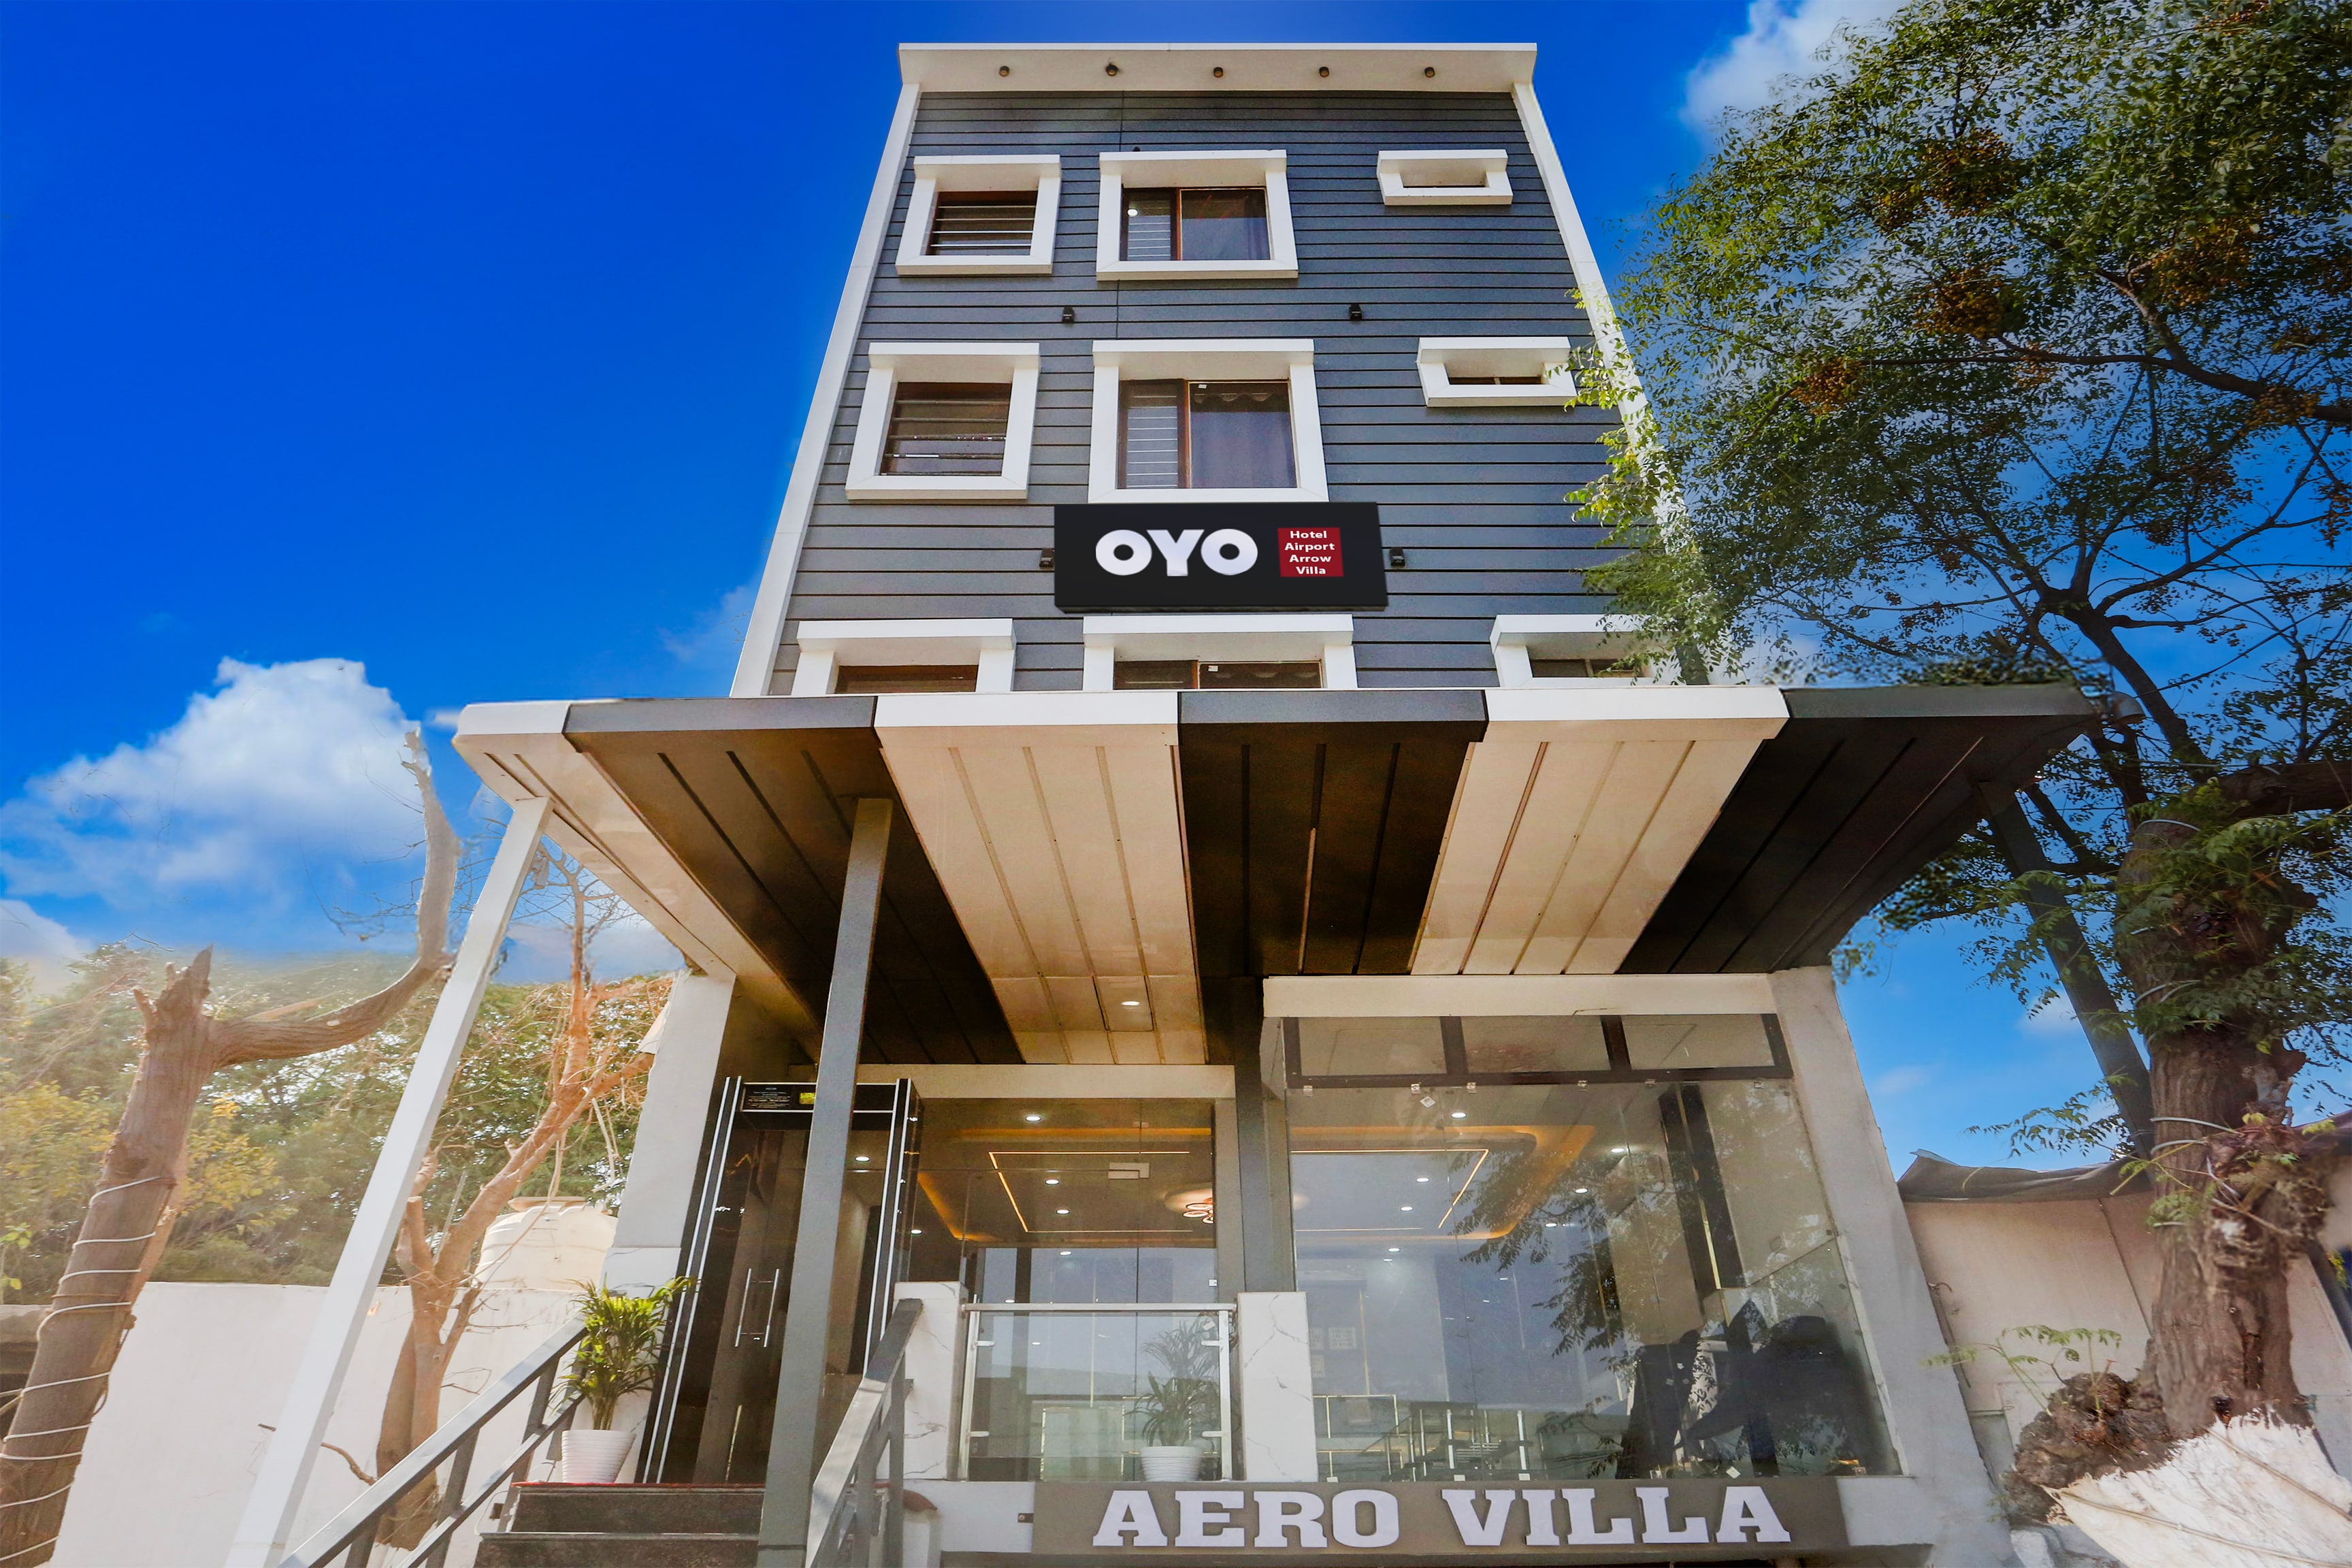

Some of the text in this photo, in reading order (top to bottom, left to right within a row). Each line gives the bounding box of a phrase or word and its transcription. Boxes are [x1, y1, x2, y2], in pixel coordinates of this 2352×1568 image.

[1290, 530, 1328, 539] Hotel
[1096, 529, 1258, 576] OYO
[1284, 542, 1335, 553] Airport
[1289, 554, 1332, 562] Arrow
[1295, 566, 1326, 574] Villa
[1092, 1486, 1792, 1548] AERO VILLA
